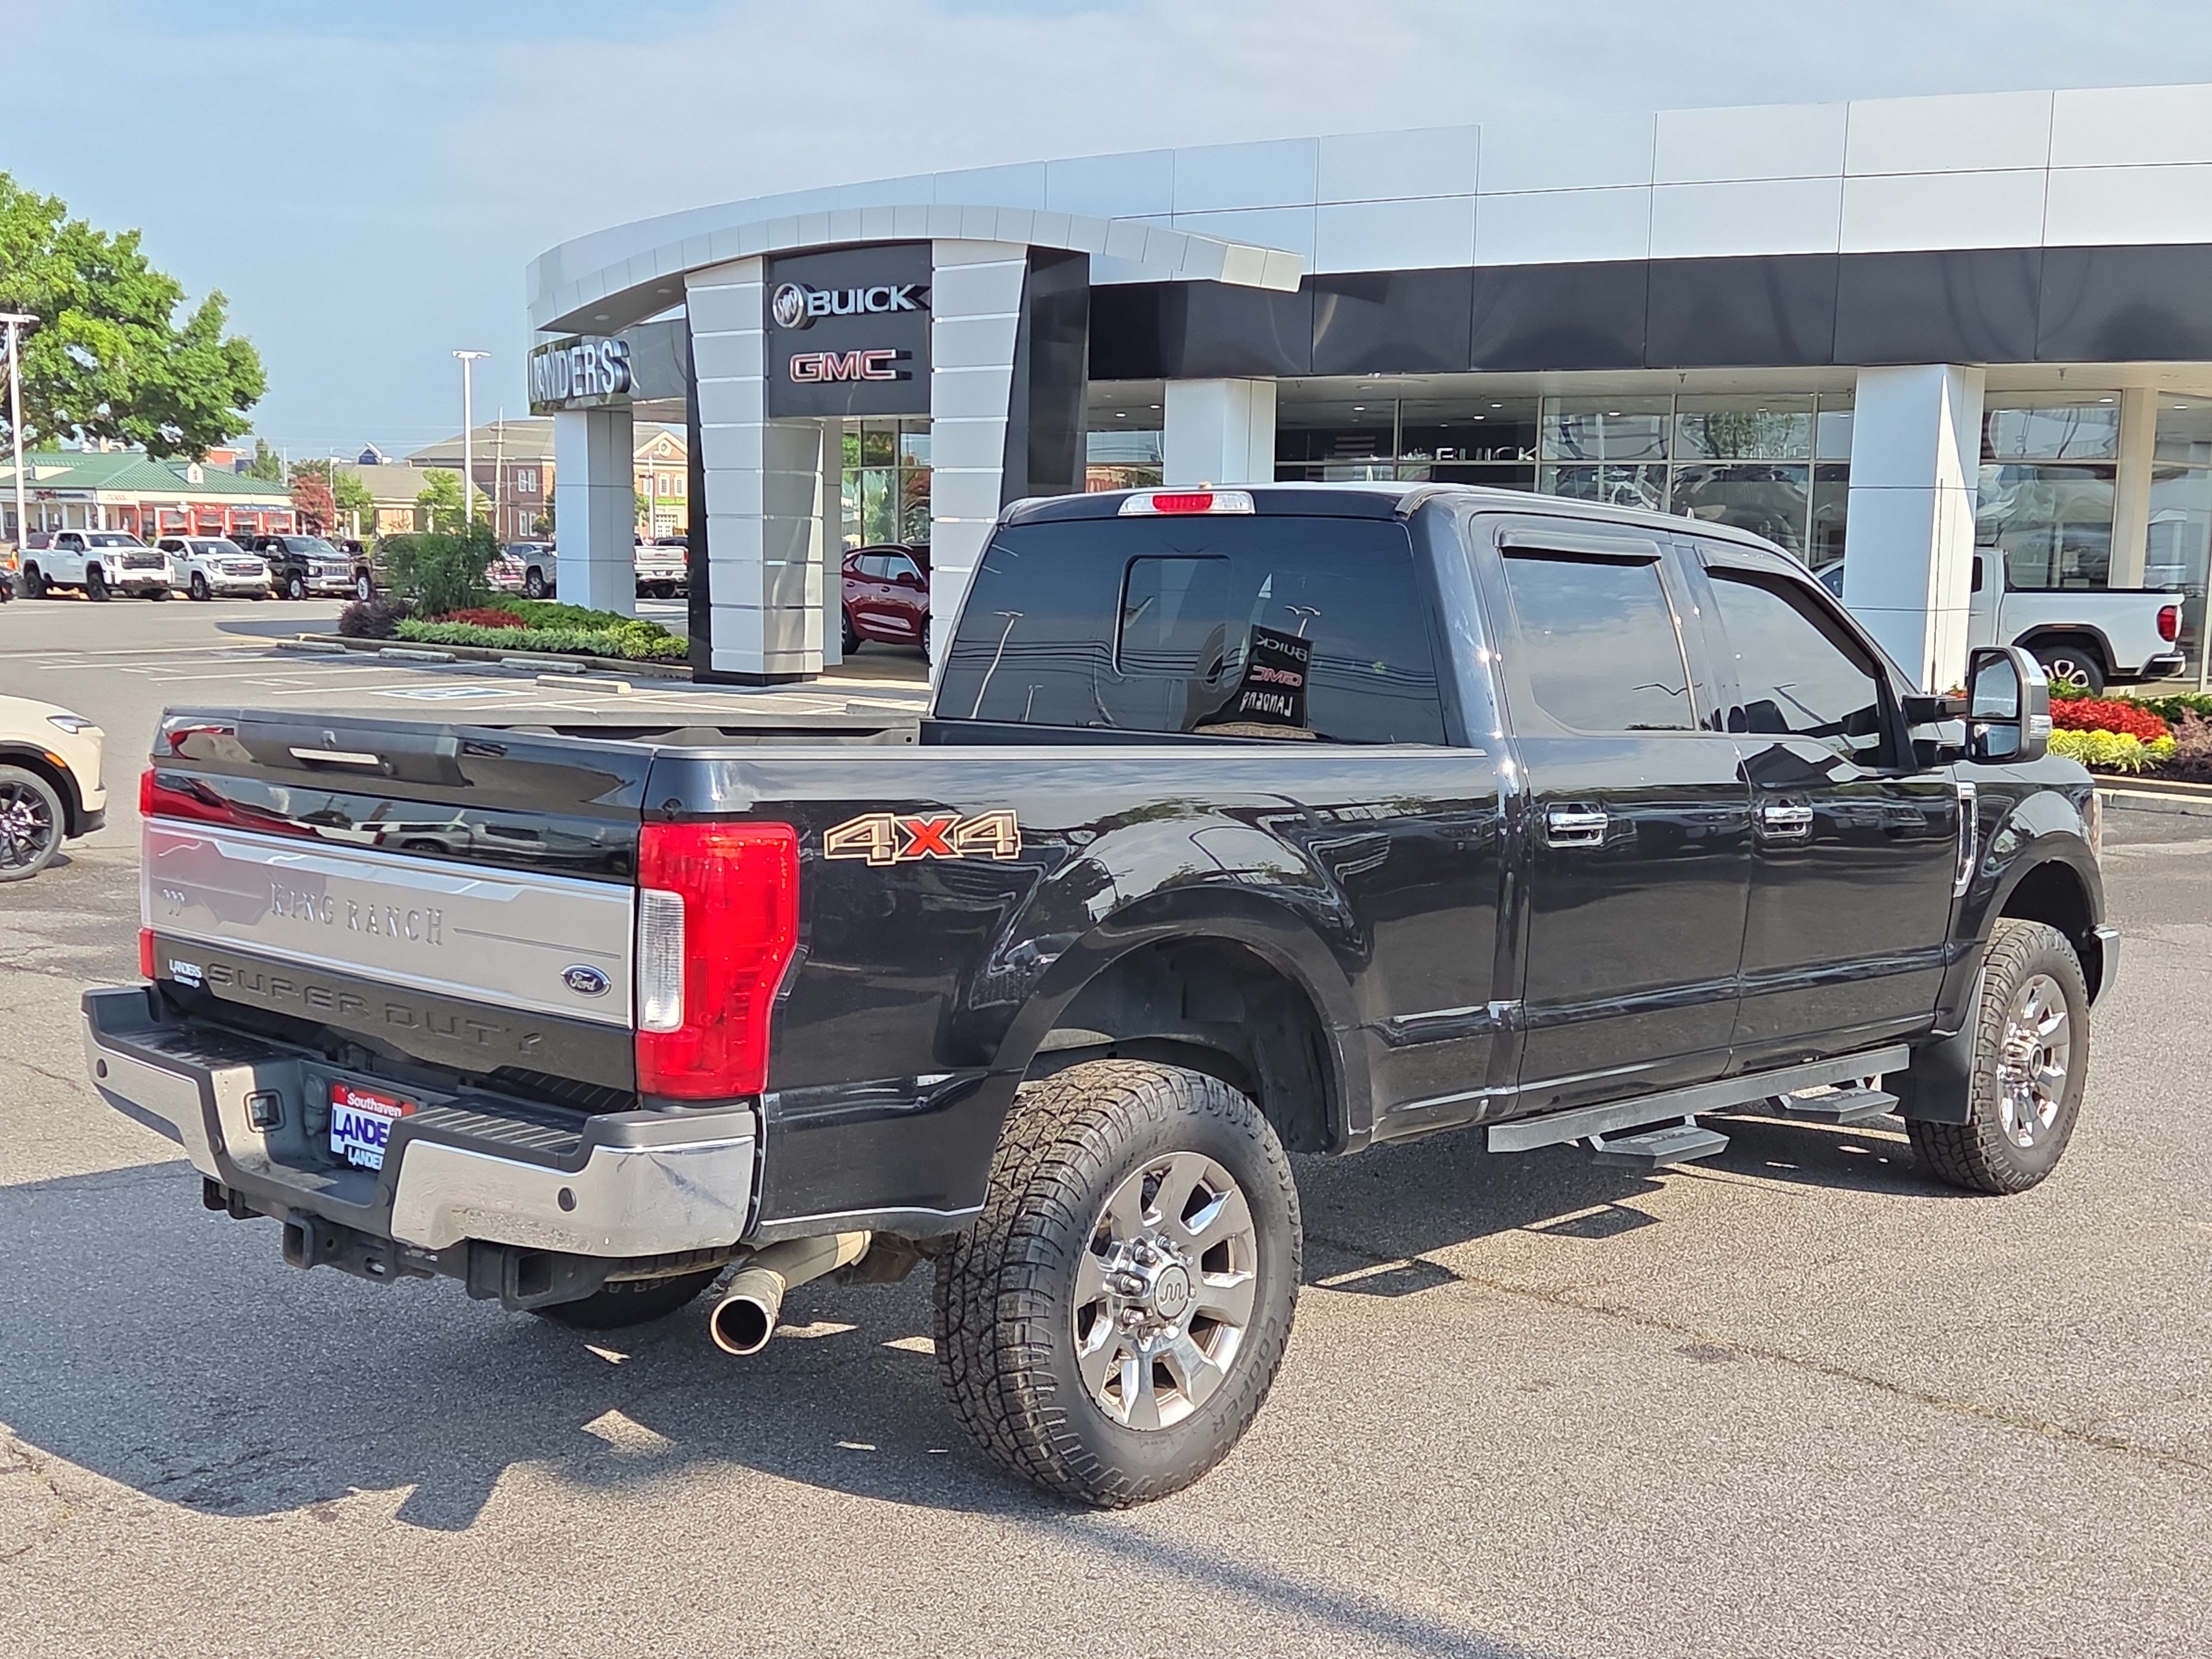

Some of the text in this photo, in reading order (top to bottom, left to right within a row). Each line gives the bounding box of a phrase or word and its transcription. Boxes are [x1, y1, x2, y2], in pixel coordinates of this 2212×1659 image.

[807, 283, 917, 317] BUICK
[529, 339, 617, 402] LANDERS
[789, 348, 897, 383] GMC
[270, 882, 443, 946] KING RANCH
[569, 970, 598, 991] Ford
[207, 962, 542, 1055] SUPER DUTY
[346, 1092, 403, 1118] Southaven
[332, 1109, 389, 1149] LANDE
[347, 1147, 384, 1171] LANDE
[1212, 1316, 1277, 1435] COOPER
